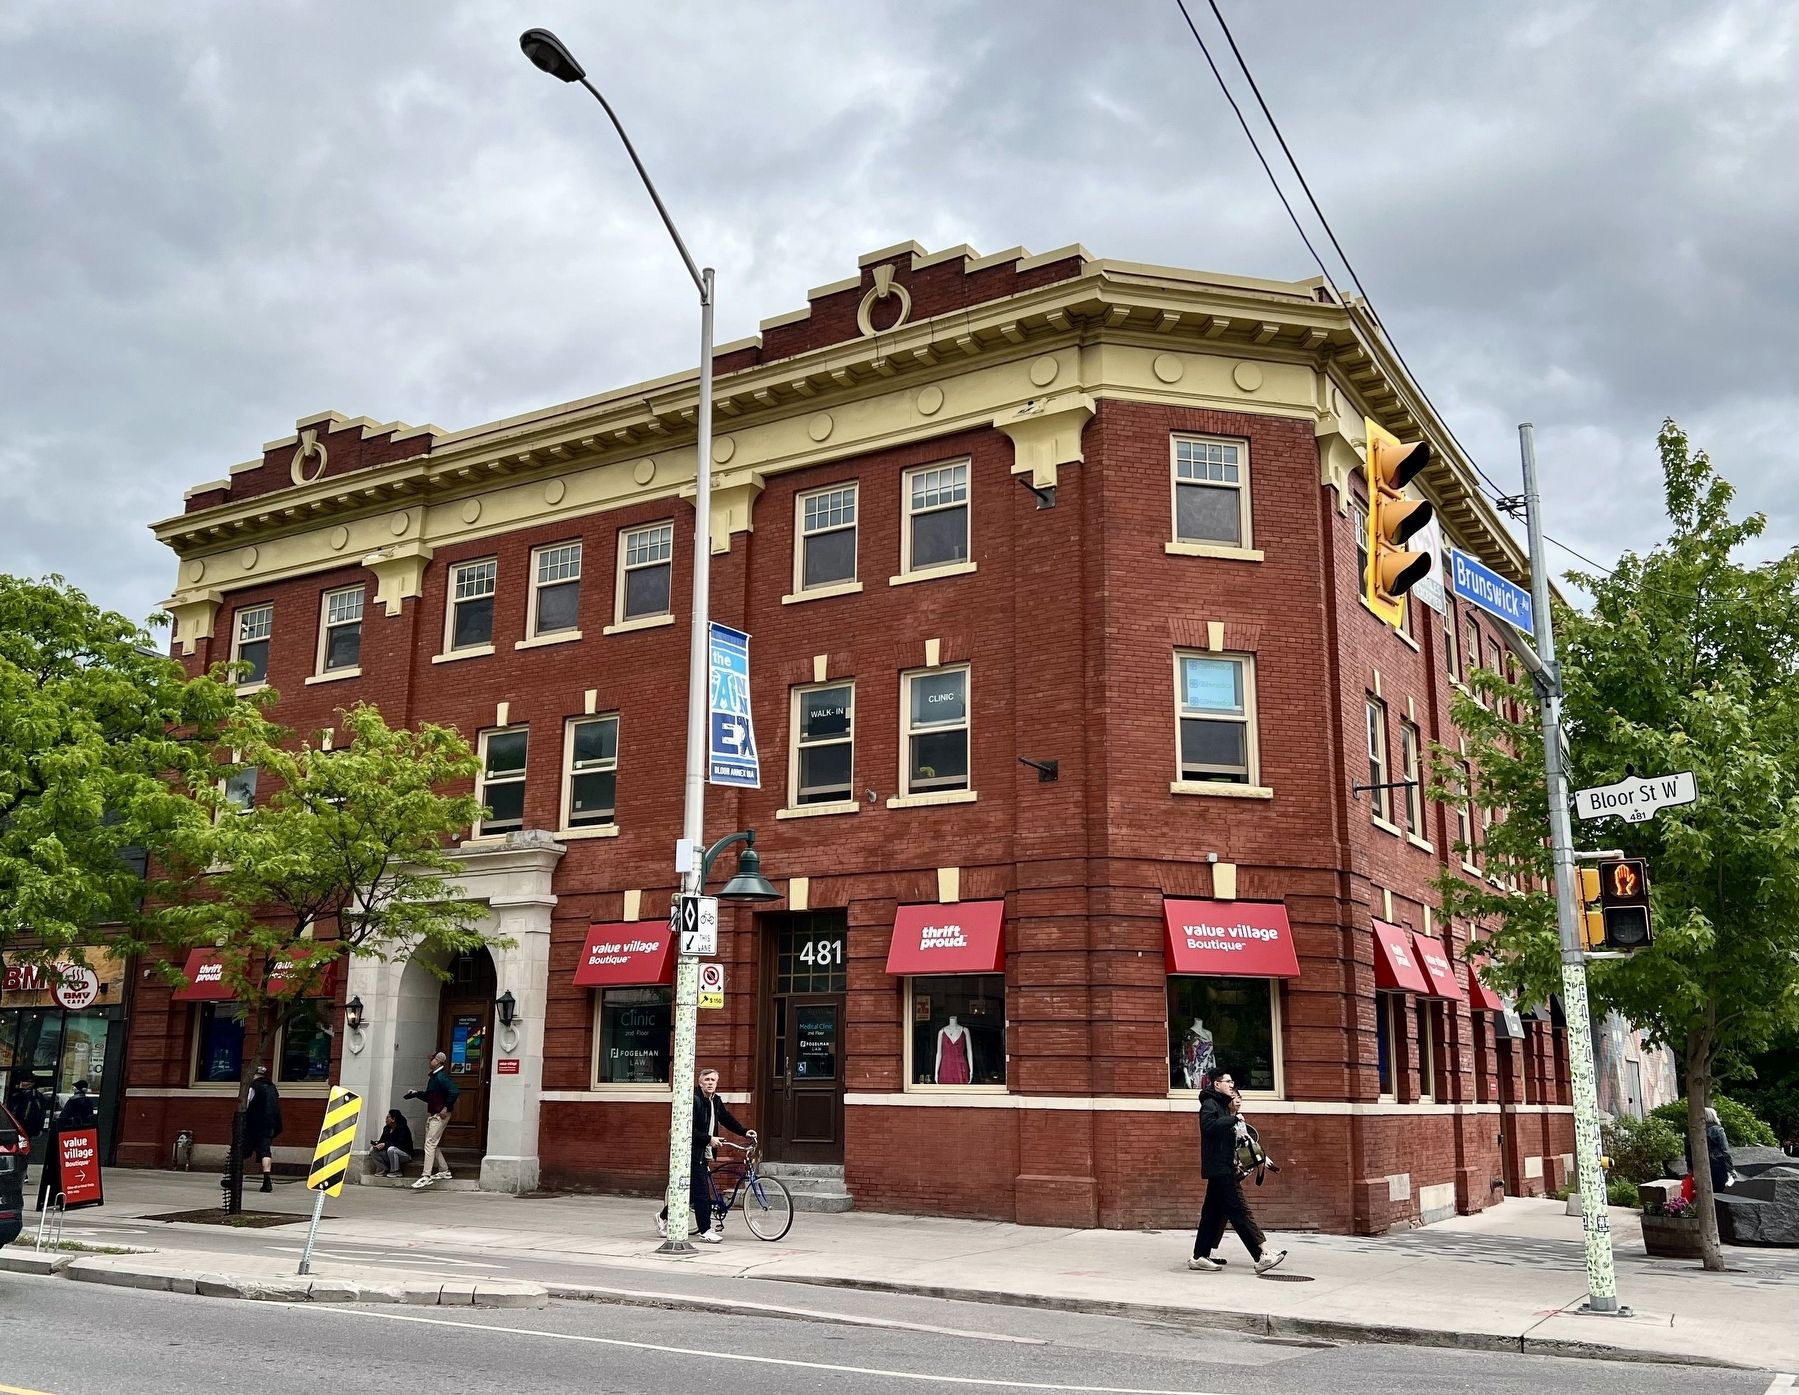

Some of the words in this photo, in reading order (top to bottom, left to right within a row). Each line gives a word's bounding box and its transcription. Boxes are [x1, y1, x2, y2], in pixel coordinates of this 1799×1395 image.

[1457, 556, 1519, 617] Brunswick
[712, 651, 732, 667] the
[928, 693, 954, 703] CLINIC
[1590, 791, 1634, 810] Bloor
[1639, 785, 1657, 802] St
[1661, 781, 1677, 798] W
[1630, 812, 1647, 820] 481
[922, 925, 961, 938] thrift
[1183, 923, 1225, 937] value
[1227, 924, 1278, 941] village
[592, 942, 621, 954] value
[623, 940, 660, 953] village
[920, 934, 967, 950] proud.
[799, 939, 842, 966] 481
[199, 963, 223, 974] thrift
[621, 1009, 656, 1026] Clinic
[63, 1137, 88, 1148] value
[64, 1148, 94, 1159] village
